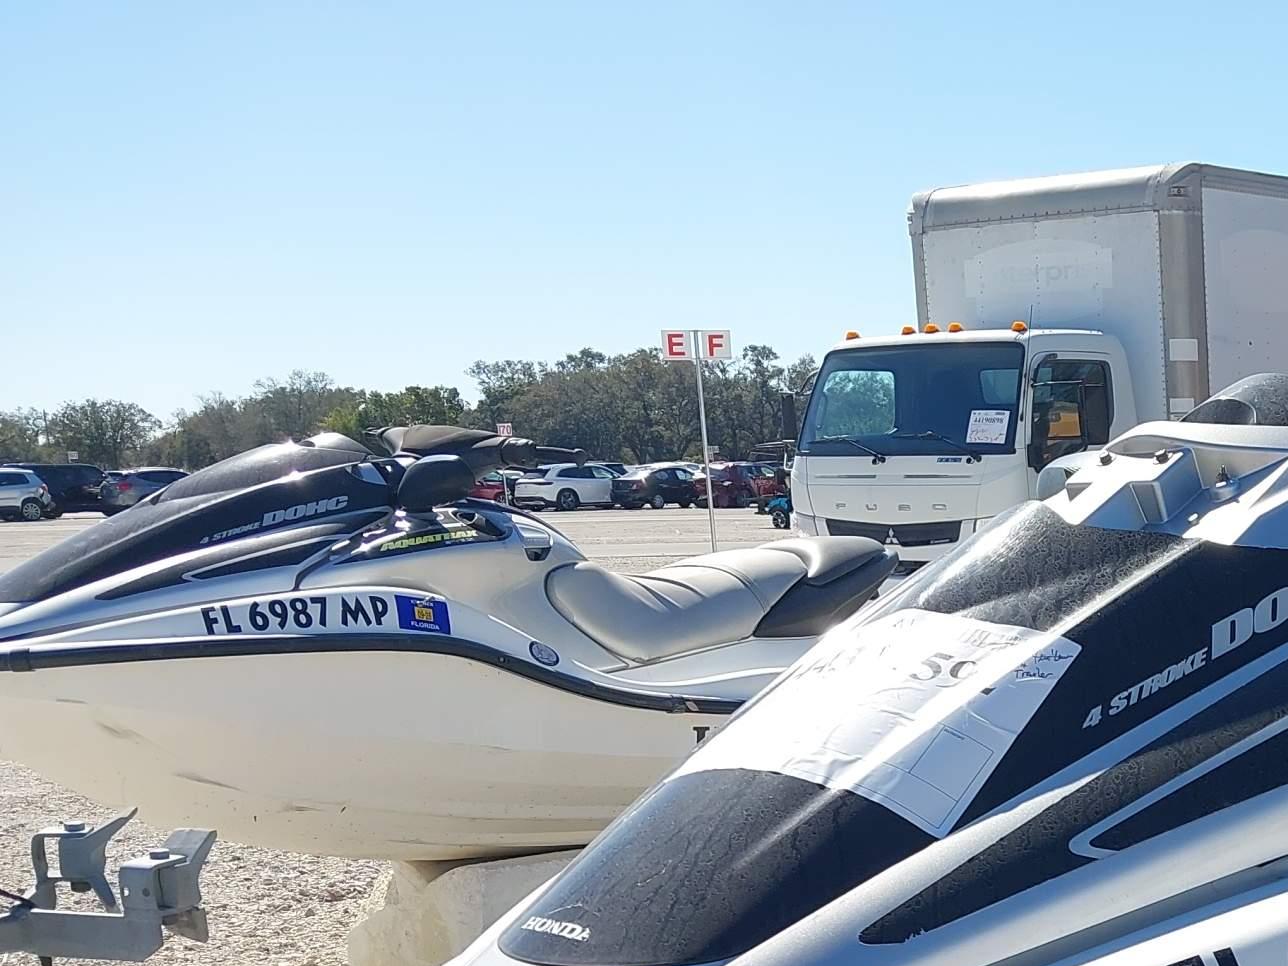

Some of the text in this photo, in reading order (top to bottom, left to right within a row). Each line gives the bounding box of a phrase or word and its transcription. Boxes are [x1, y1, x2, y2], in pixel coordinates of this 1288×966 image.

[667, 333, 686, 356] E
[707, 334, 724, 357] F
[211, 521, 263, 542] STROKE
[262, 495, 349, 527] DOHC
[380, 530, 479, 552] AQUATRAX
[200, 595, 389, 636] FL 6987 MP
[411, 620, 440, 631] FLORIDA
[1082, 703, 1103, 730] 4
[1108, 646, 1209, 717] STROKE
[520, 916, 592, 942] HONDA
